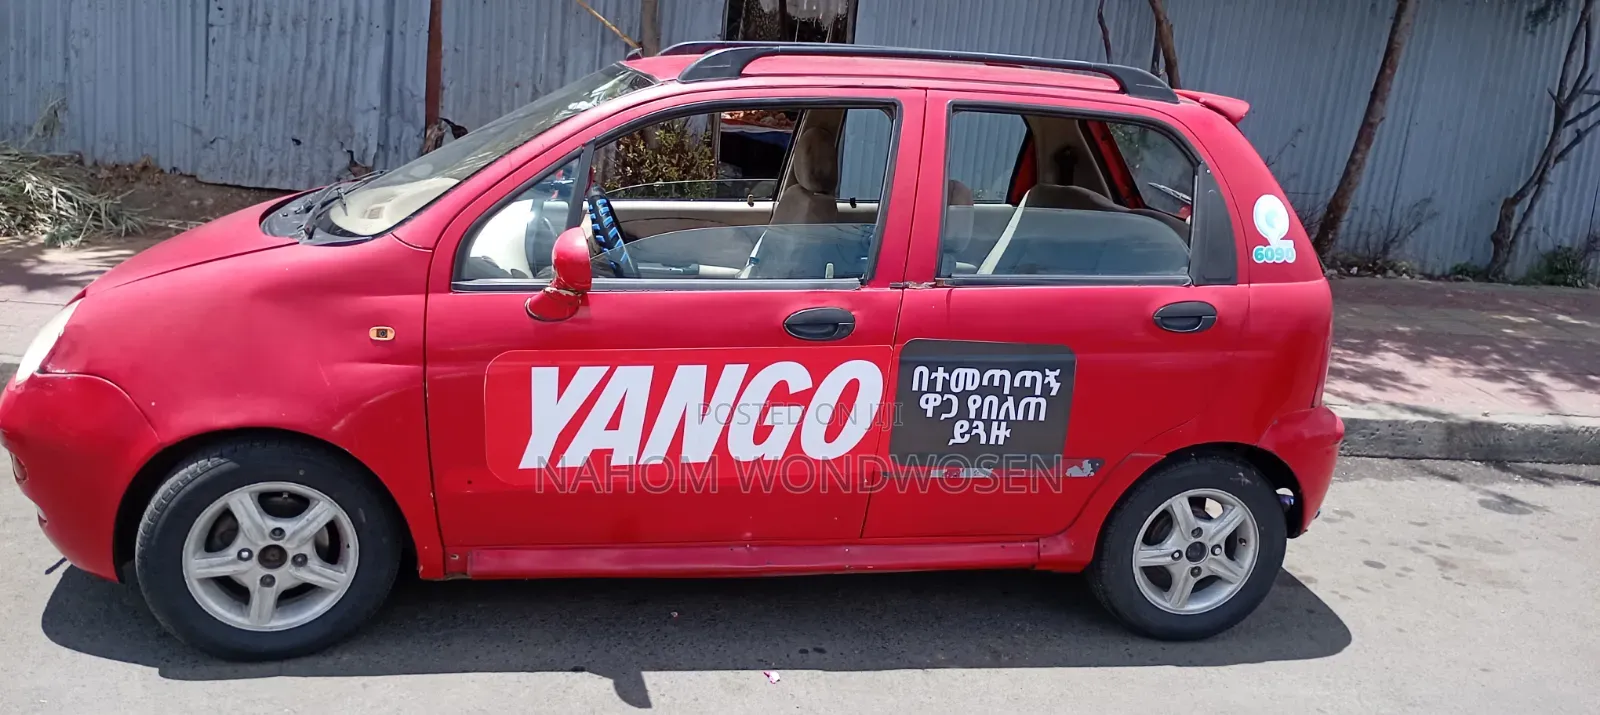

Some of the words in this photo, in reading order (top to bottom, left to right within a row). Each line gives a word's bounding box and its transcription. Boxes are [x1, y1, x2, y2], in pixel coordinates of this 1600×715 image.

[1254, 247, 1295, 262] 6090
[911, 365, 1062, 396] በተመጣጣኝ
[518, 359, 884, 469] YANGO
[919, 393, 959, 420] ዋጋ
[967, 394, 1047, 421] የበለጠ
[948, 419, 1011, 446] ይጓዙ
